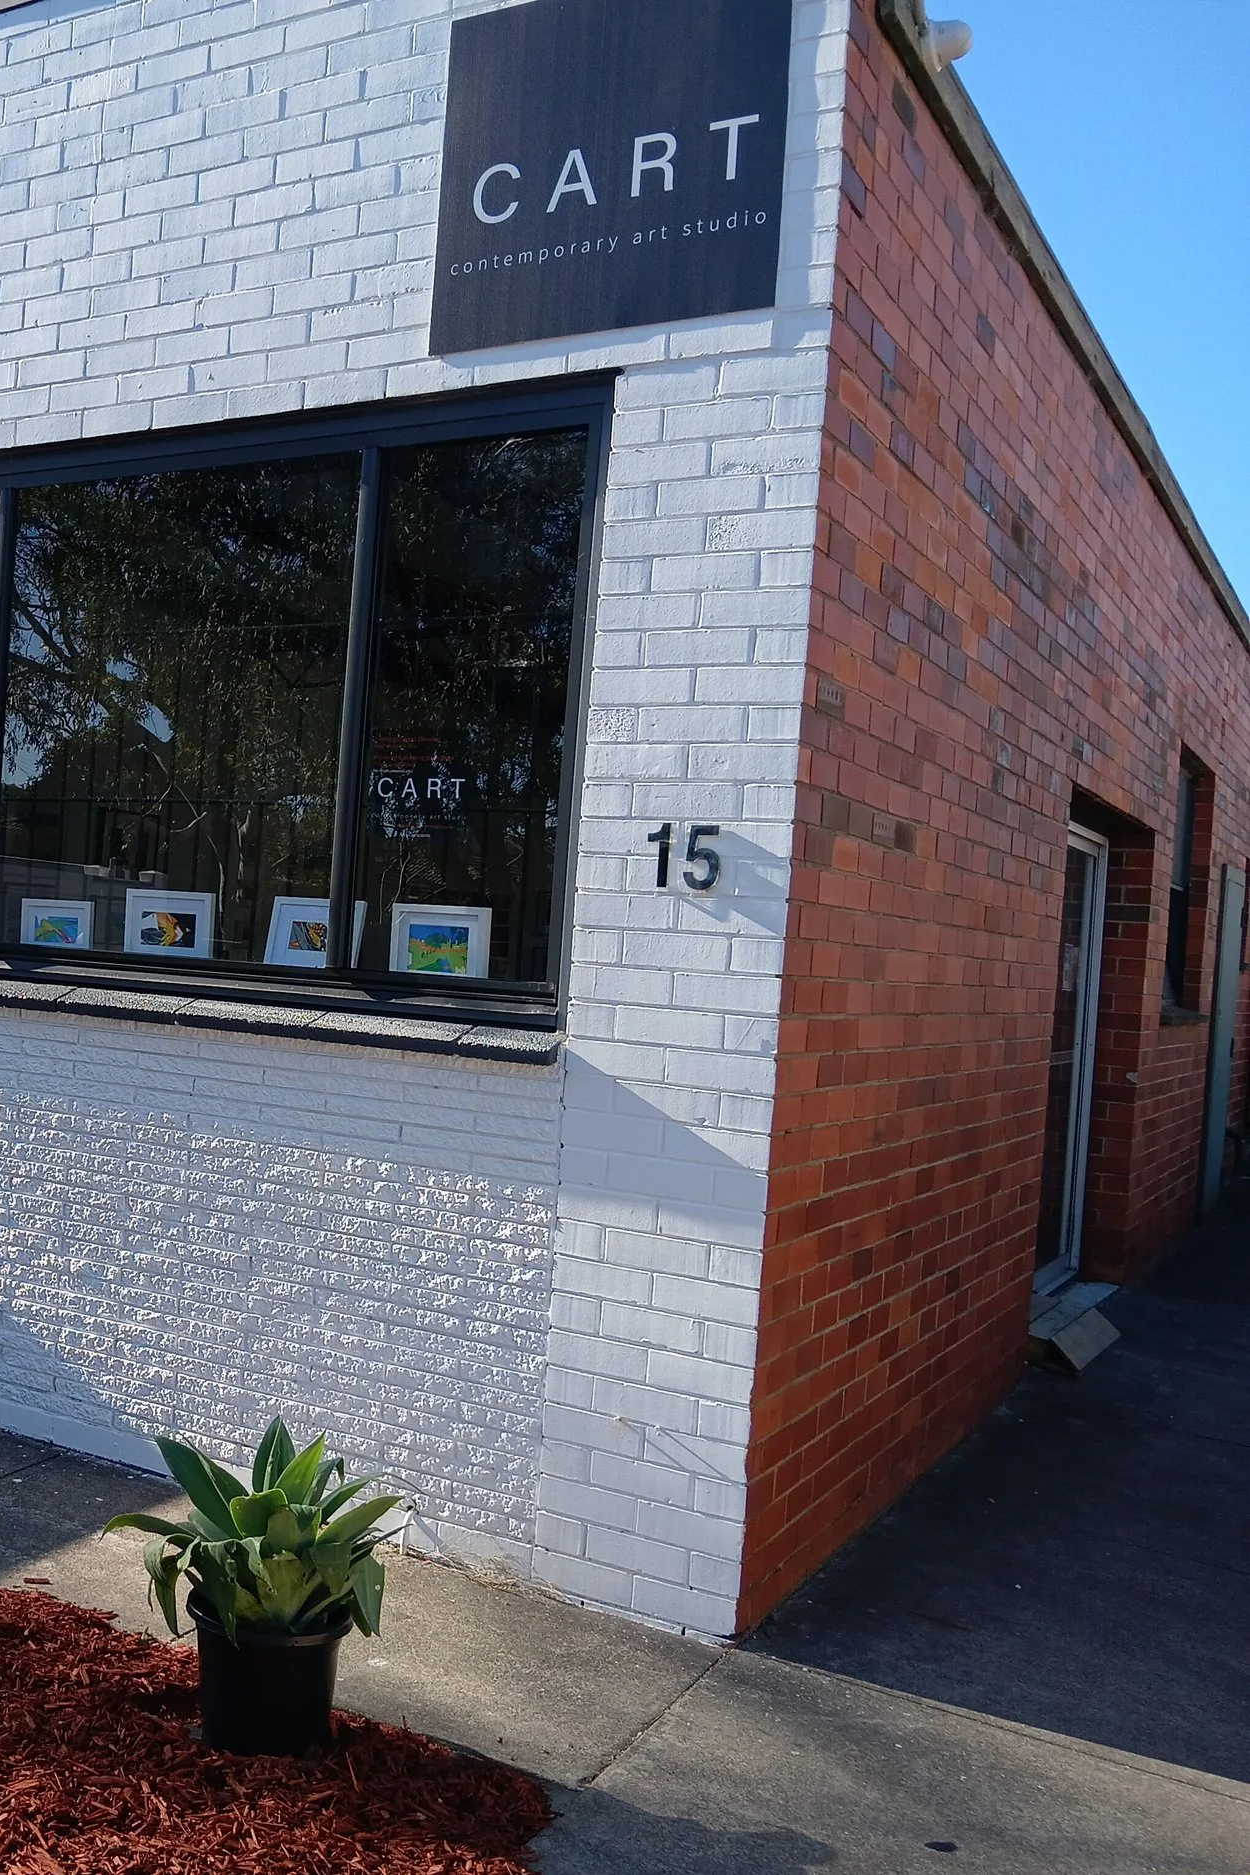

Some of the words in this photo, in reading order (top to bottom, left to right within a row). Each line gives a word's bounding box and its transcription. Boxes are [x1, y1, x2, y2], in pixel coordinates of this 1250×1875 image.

[472, 113, 760, 225] CART
[450, 234, 619, 276] contemporary
[632, 224, 668, 245] art
[682, 209, 767, 237] studio
[379, 777, 466, 799] CART
[647, 823, 721, 890] 15
